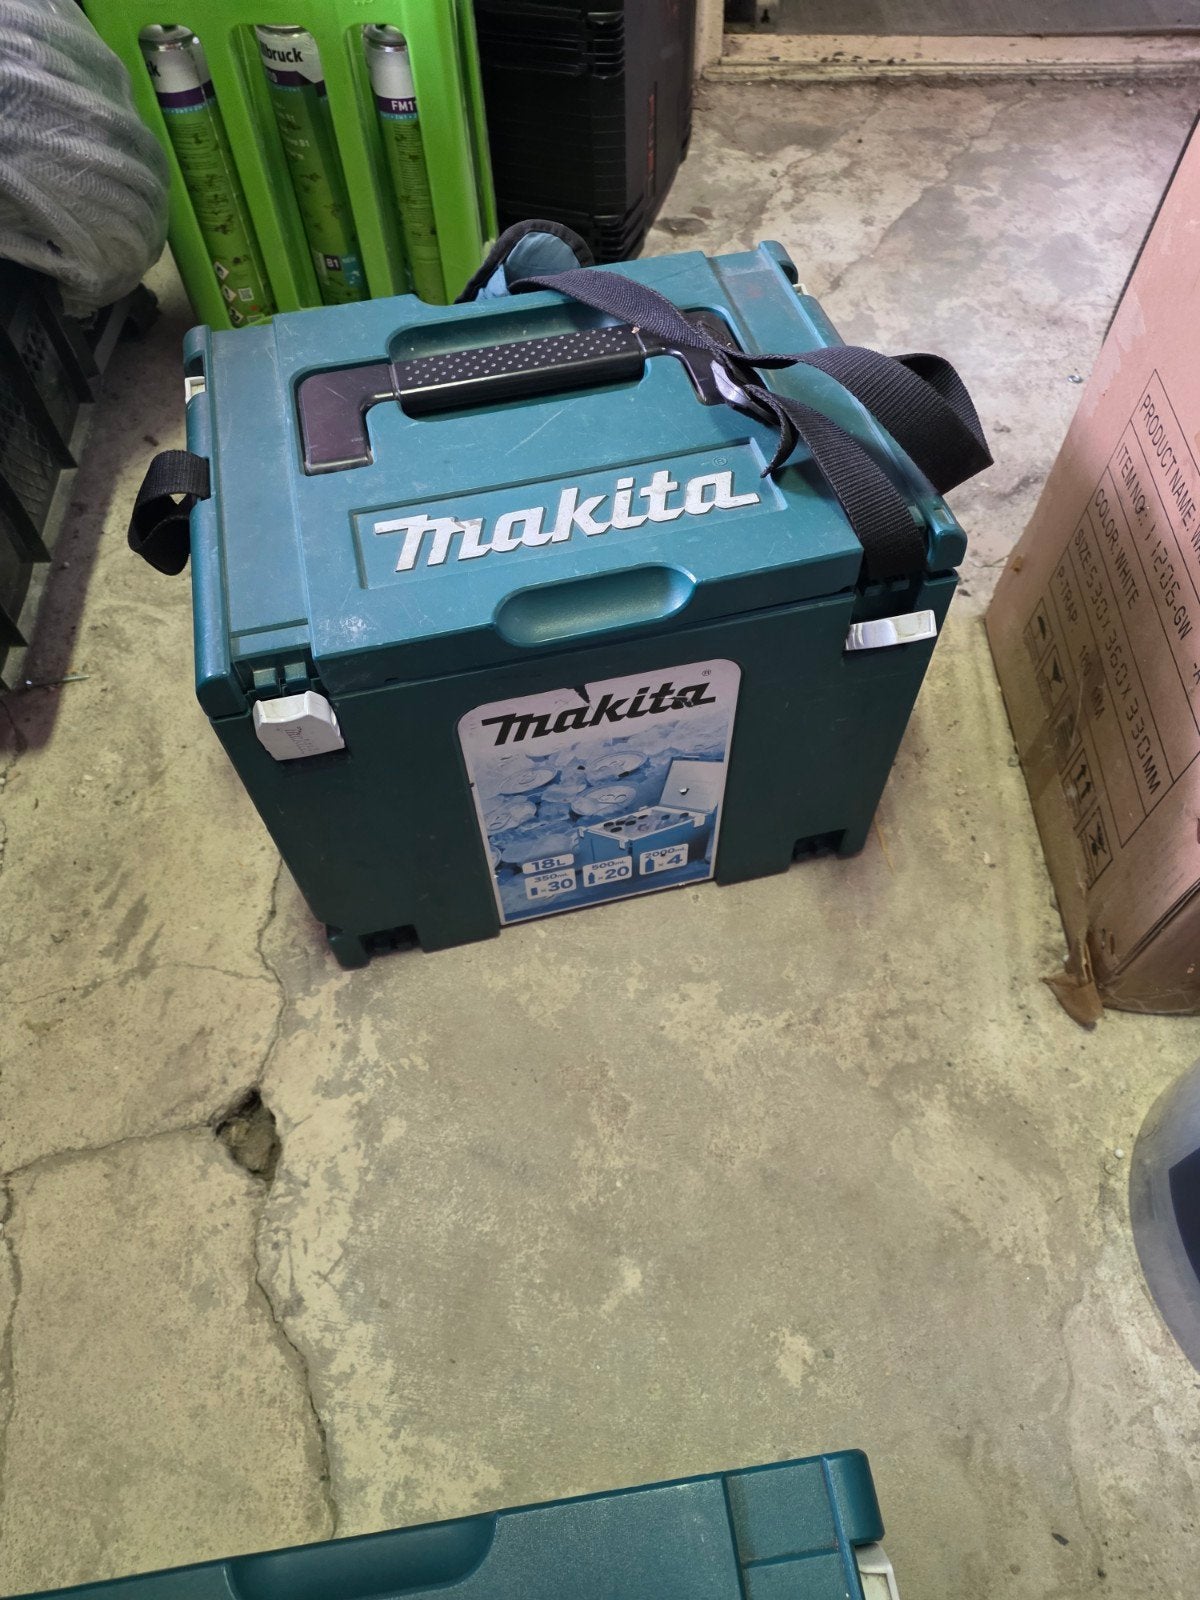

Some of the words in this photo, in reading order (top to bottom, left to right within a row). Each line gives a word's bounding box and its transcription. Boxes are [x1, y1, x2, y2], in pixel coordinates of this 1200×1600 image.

[1116, 442, 1136, 490] ITEM
[1140, 393, 1177, 478] PRODUCT
[1168, 467, 1197, 532] NAME:
[373, 469, 760, 573] makita
[1095, 488, 1119, 555] COLOR:
[1114, 547, 1140, 610] WHITE
[481, 682, 716, 746] makita
[531, 859, 566, 872] 18L
[548, 878, 574, 893] 30
[605, 866, 630, 880] 20
